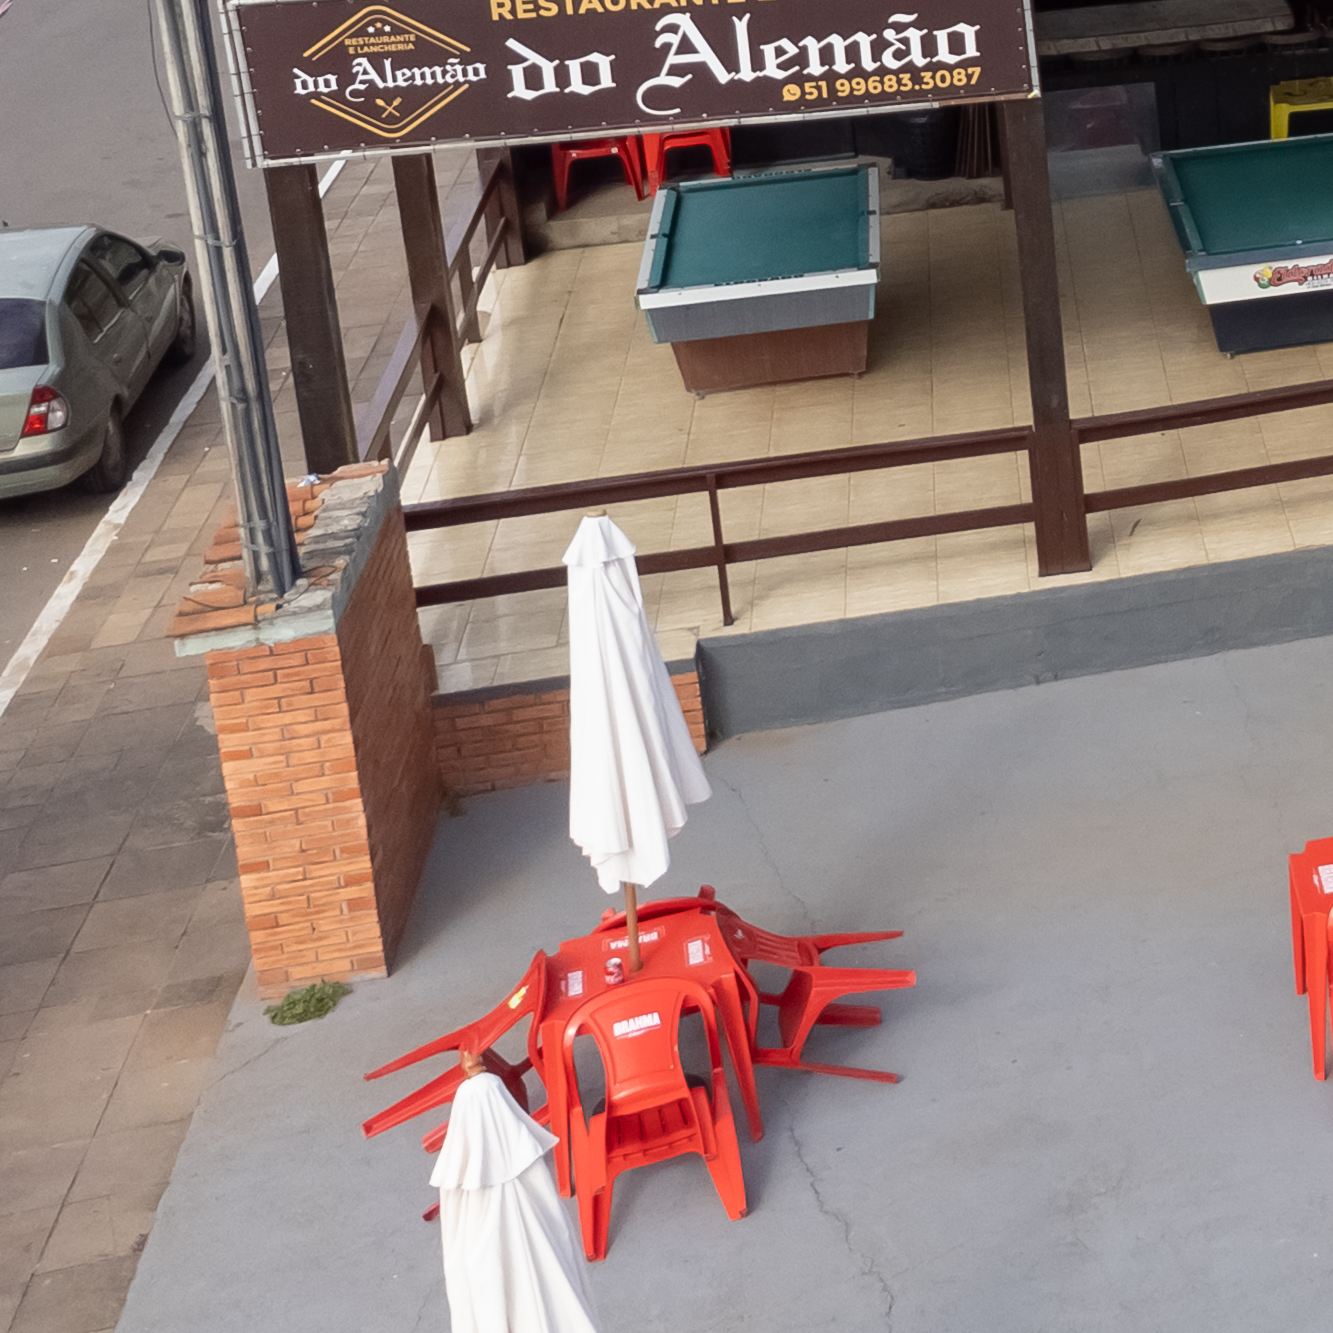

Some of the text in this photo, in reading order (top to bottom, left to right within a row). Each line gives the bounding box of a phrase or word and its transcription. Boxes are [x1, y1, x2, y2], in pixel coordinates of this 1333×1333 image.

[344, 34, 416, 46] RESTAURANTE
[349, 43, 415, 54] E LANCHERIA
[505, 13, 981, 115] do Alemão
[292, 57, 487, 102] do Alemão
[804, 67, 981, 100] 51 99683.3087
[610, 931, 659, 950] BRMA
[613, 1012, 661, 1037] BRAHMA
